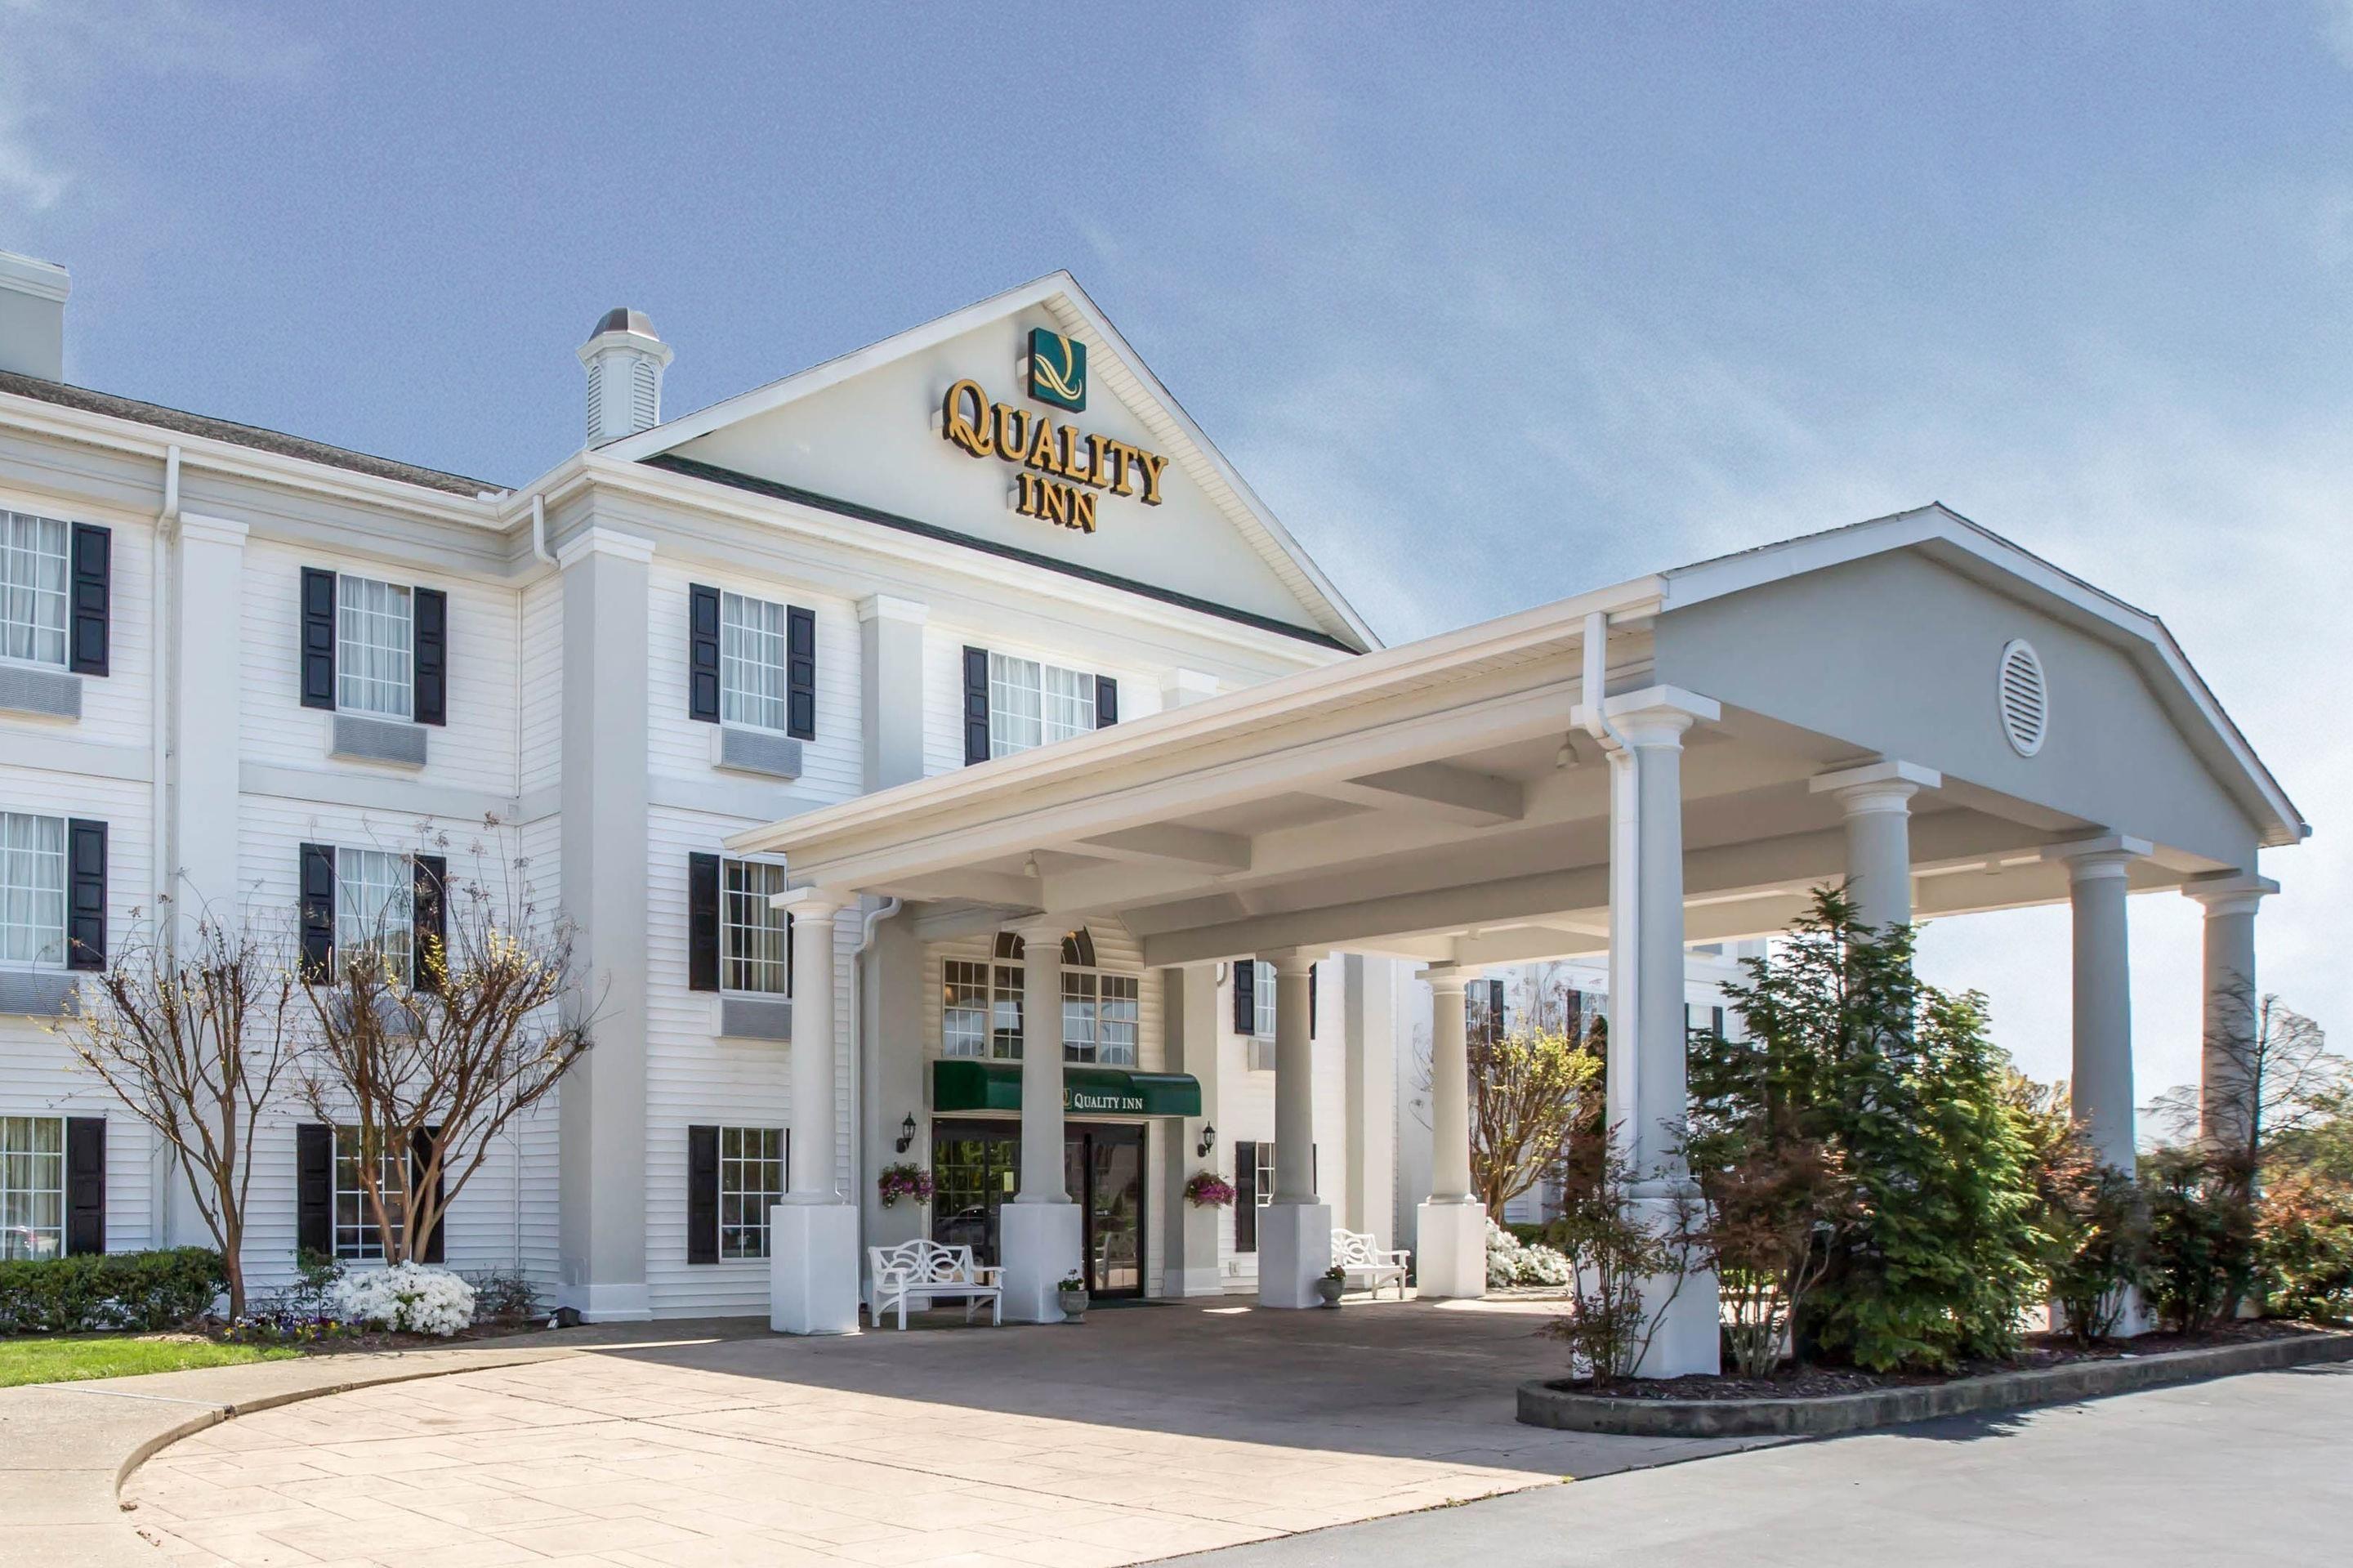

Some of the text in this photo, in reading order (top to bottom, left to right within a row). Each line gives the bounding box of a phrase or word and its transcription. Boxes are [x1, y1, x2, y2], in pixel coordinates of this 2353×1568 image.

[943, 378, 1168, 506] QUALITY
[1016, 472, 1098, 534] INN
[1074, 1093, 1119, 1109] QUALITY
[1123, 1098, 1143, 1110] INN
